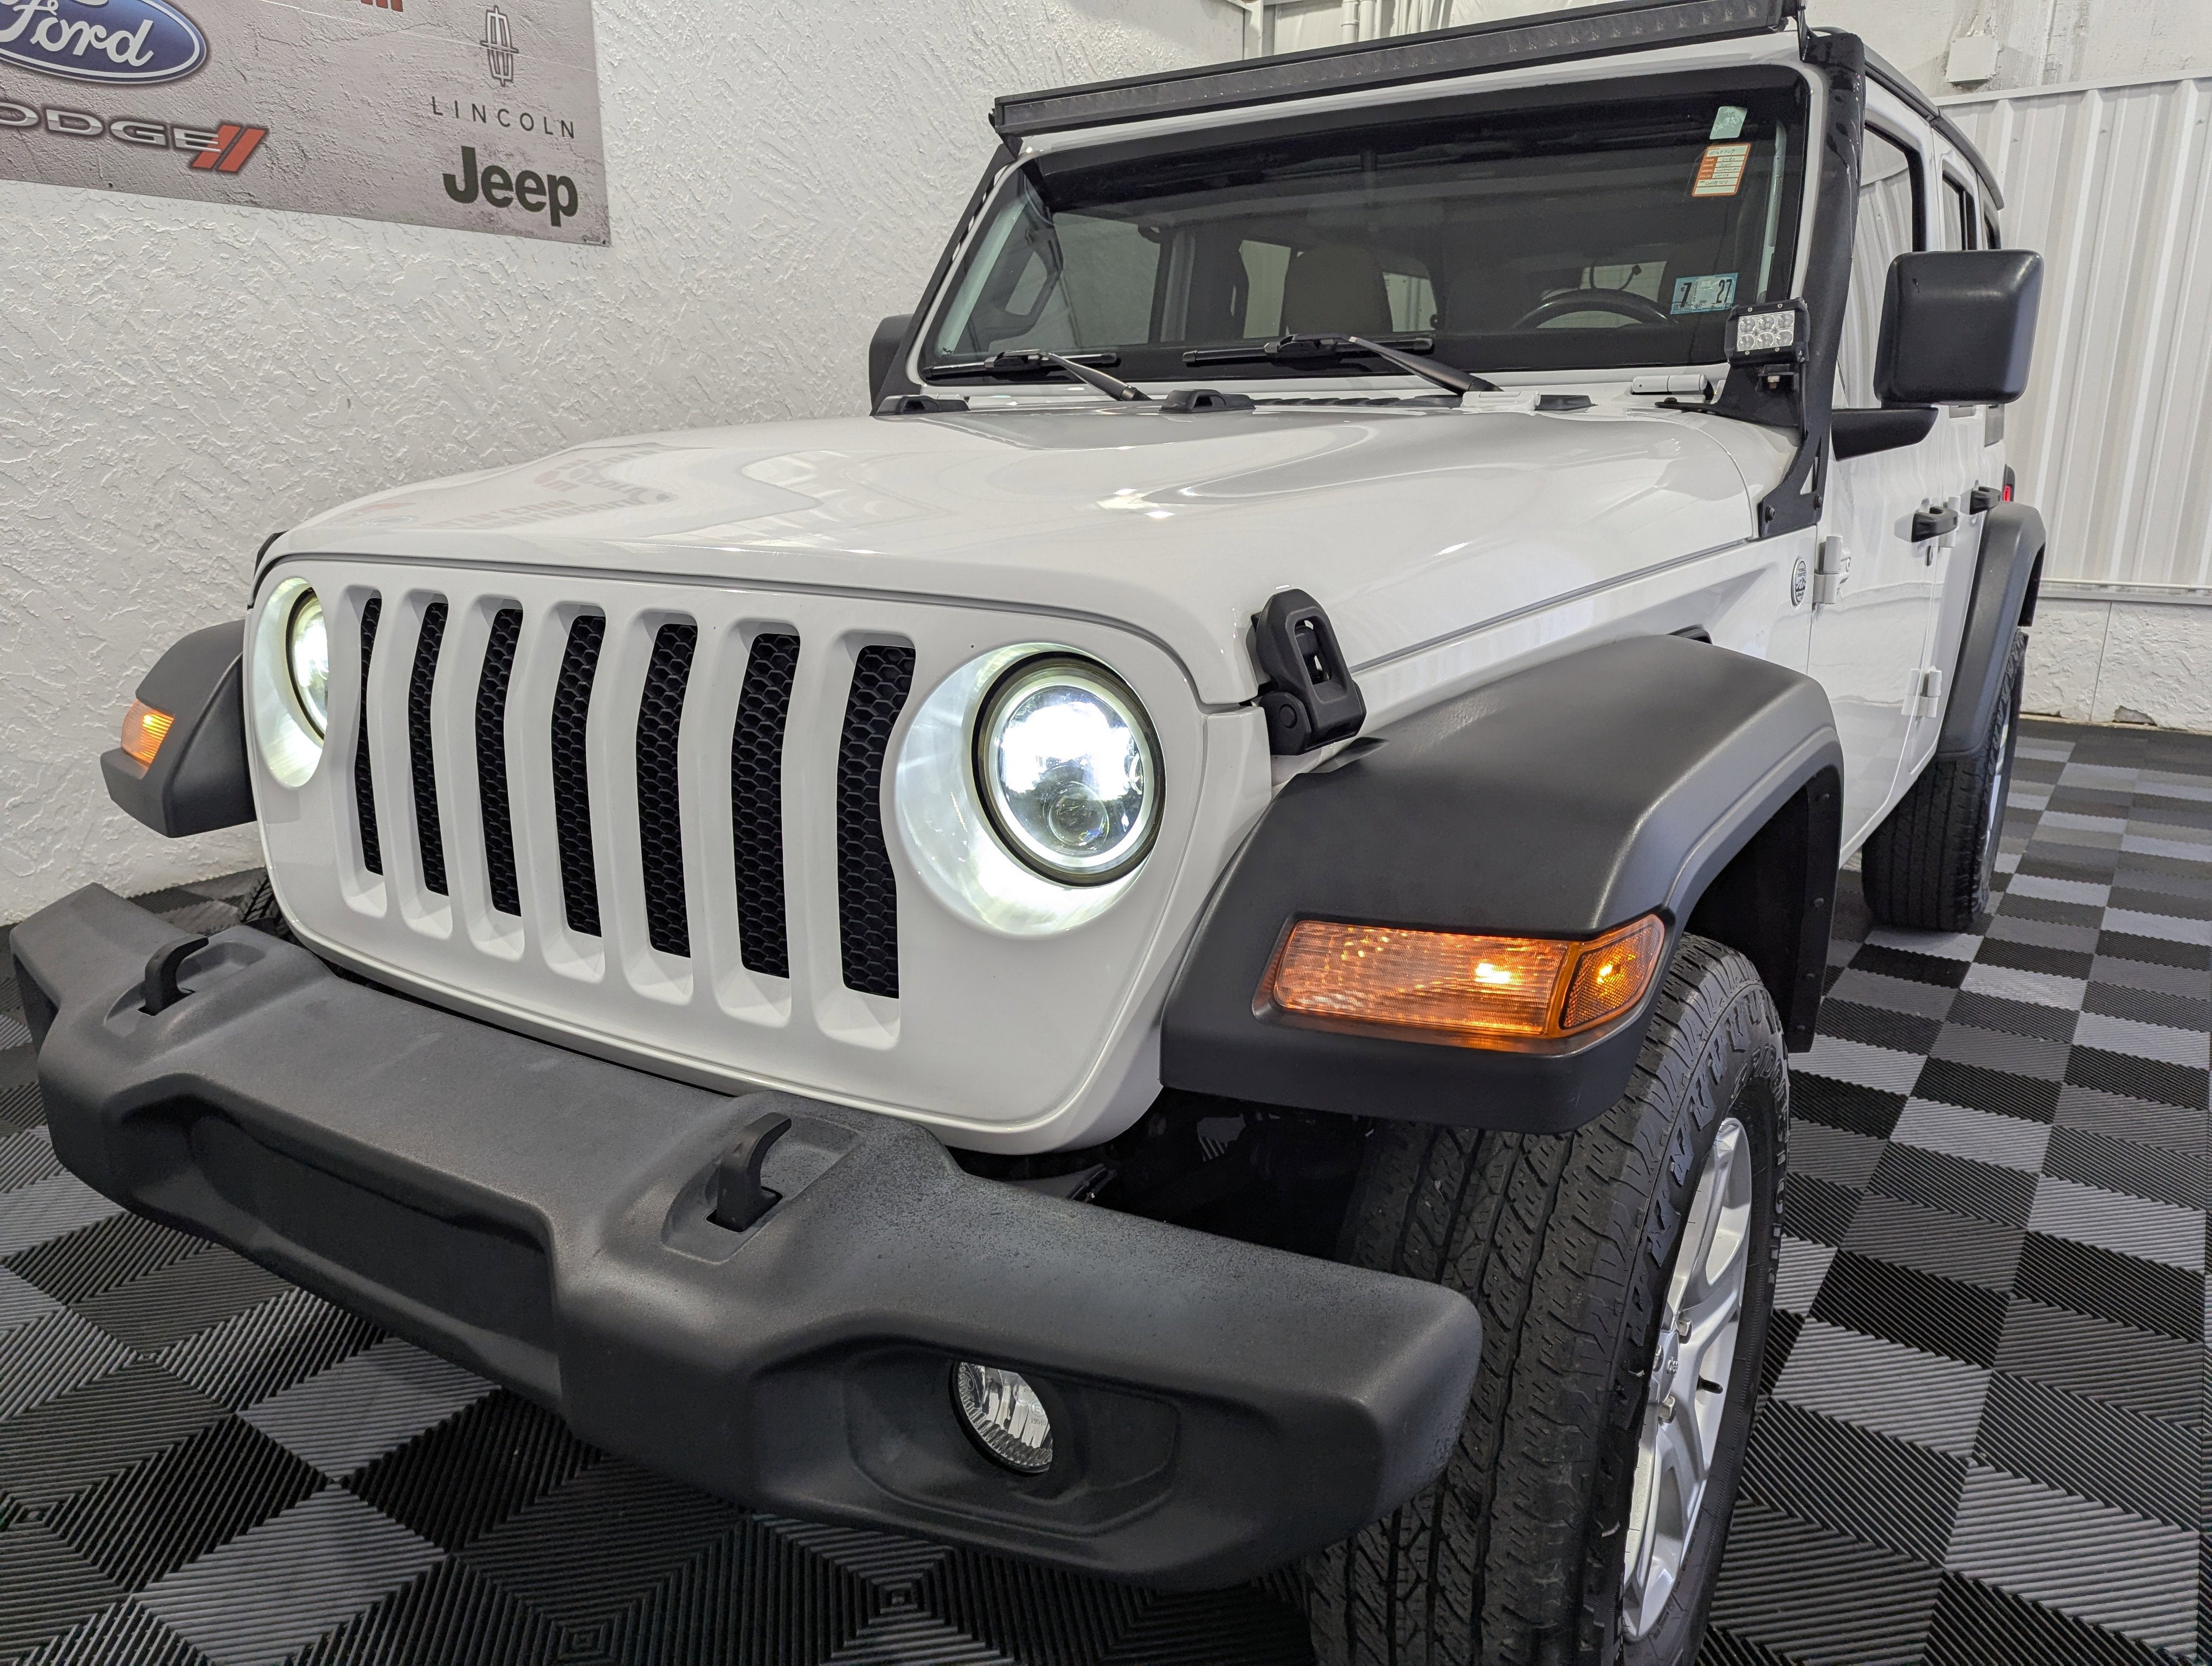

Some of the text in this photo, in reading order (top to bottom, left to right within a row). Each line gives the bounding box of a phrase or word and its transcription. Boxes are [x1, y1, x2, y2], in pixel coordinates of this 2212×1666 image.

[432, 96, 575, 139] LINCOLN
[442, 145, 578, 227] Jeep
[1680, 282, 1692, 307] 7
[1716, 279, 1732, 303] 27
